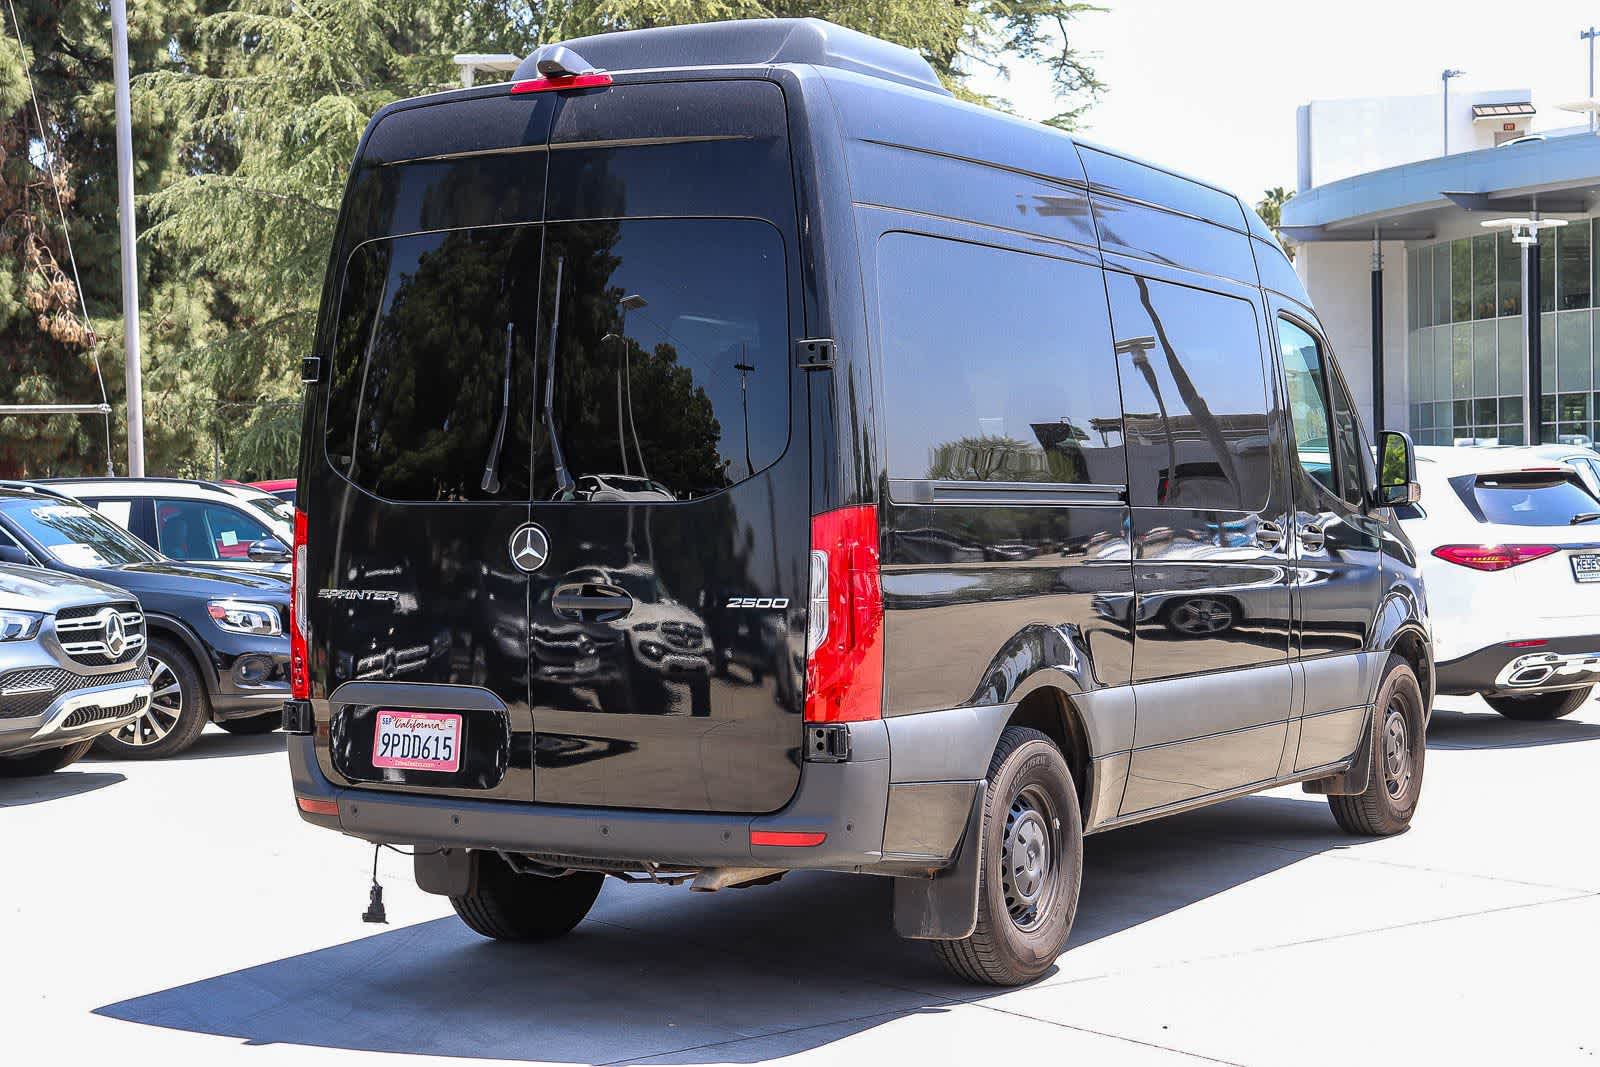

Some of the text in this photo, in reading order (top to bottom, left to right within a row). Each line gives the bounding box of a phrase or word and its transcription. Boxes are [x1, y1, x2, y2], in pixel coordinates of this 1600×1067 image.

[318, 588, 399, 601] SPRINTER
[726, 597, 789, 609] 2500
[393, 717, 445, 732] California
[380, 732, 452, 761] 9PDD615
